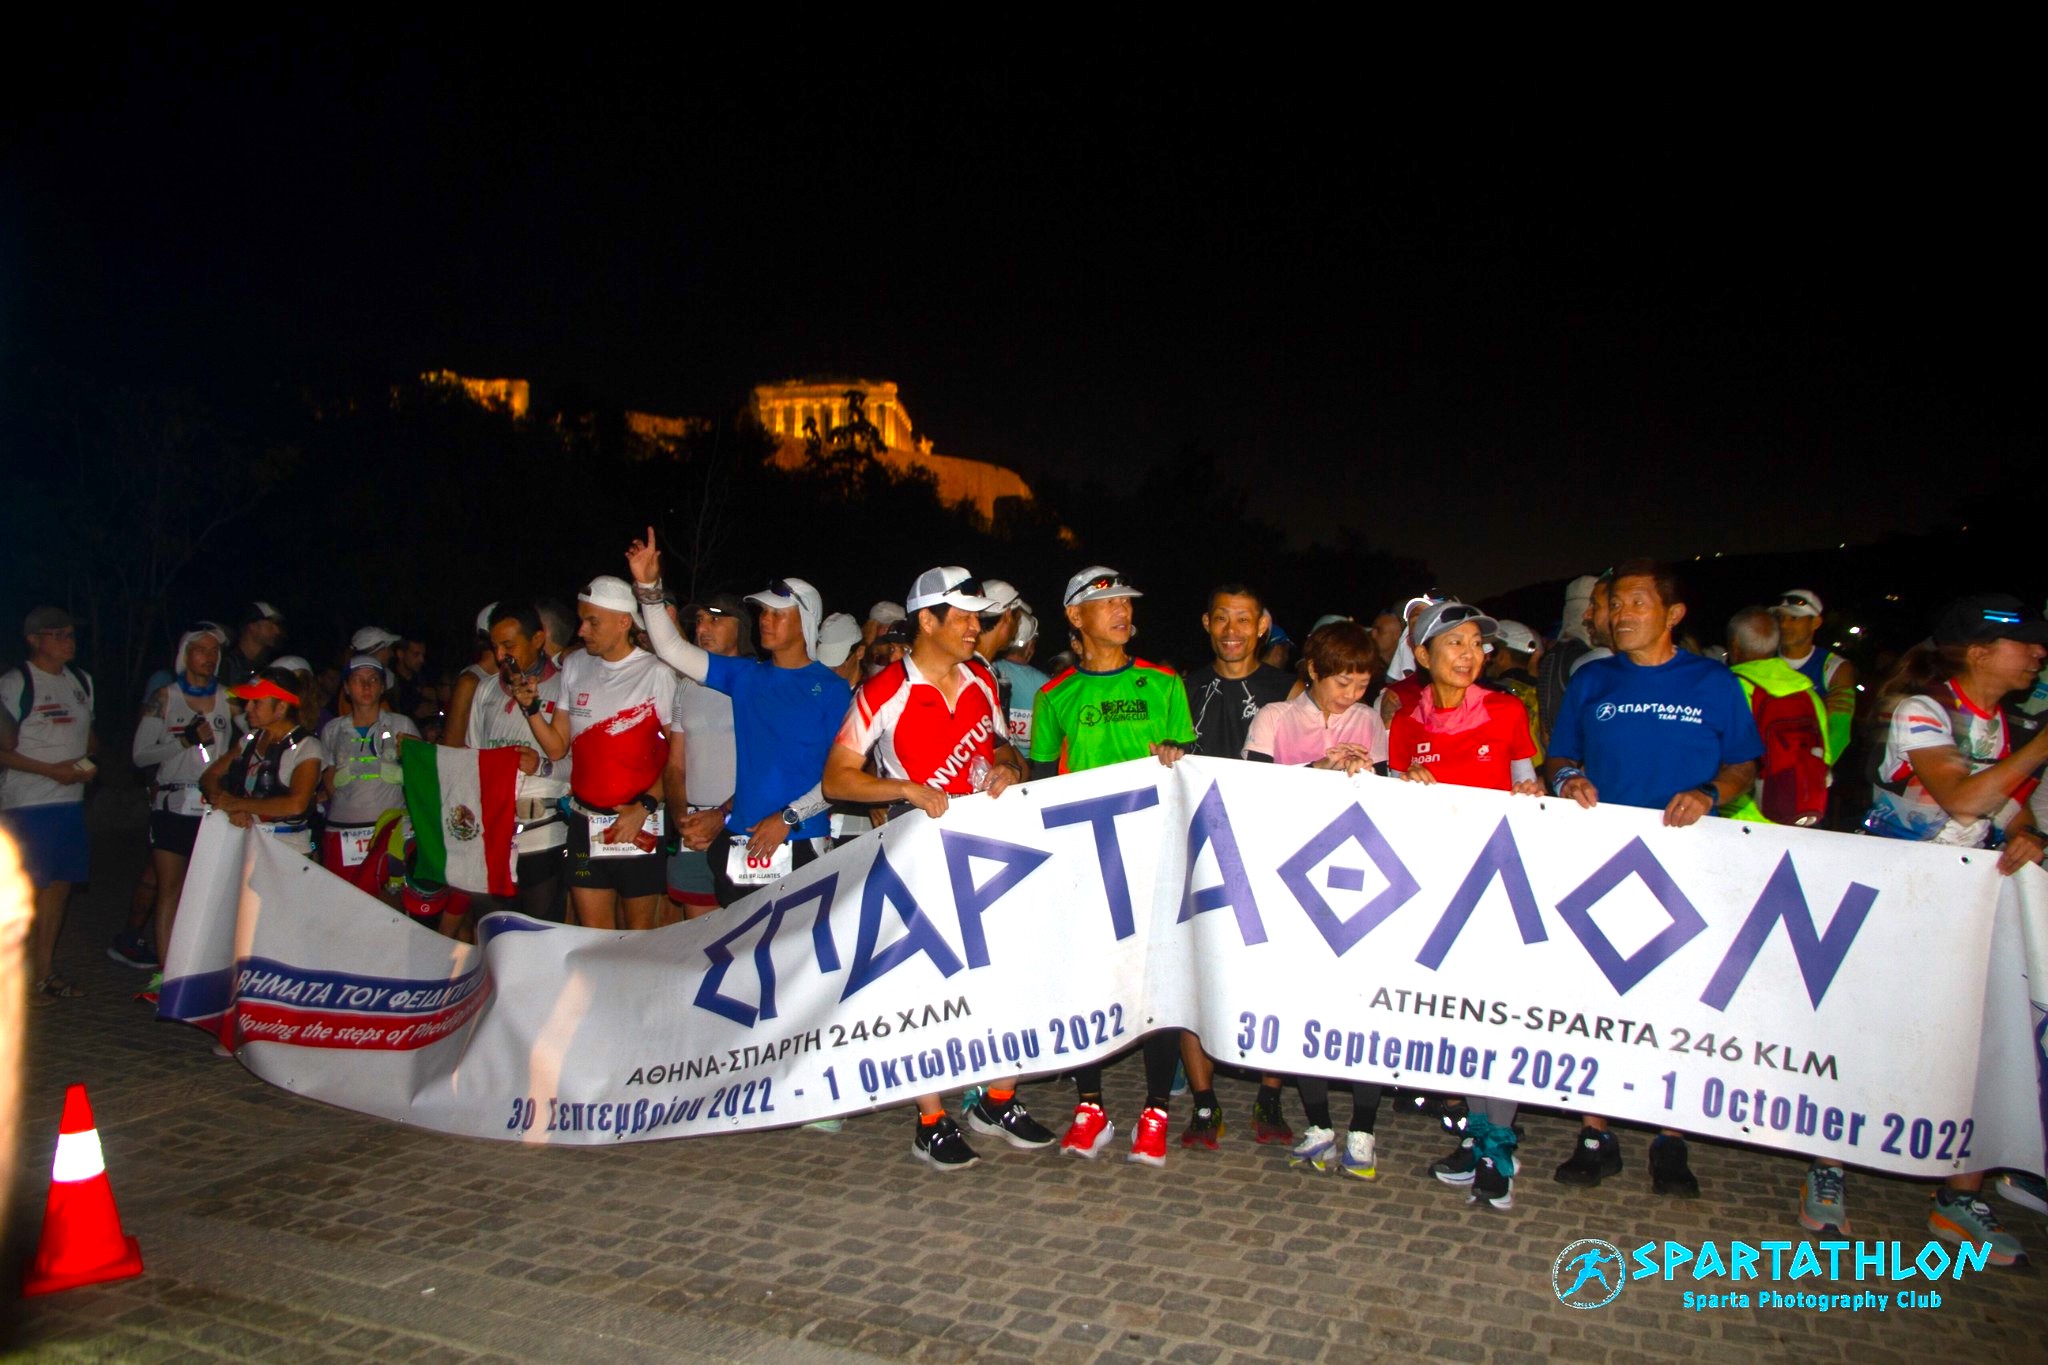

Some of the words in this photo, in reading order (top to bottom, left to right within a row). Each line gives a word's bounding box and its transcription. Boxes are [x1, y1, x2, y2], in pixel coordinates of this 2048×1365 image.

[924, 714, 994, 790] NVICTUS
[1103, 713, 1131, 723] JOGGING
[1658, 713, 1677, 721] TEAM
[1680, 715, 1702, 725] JAPAN
[237, 970, 333, 1004] ΒΗΜΑΤΑ
[336, 984, 390, 1007] ΤΟΥ
[302, 1021, 333, 1039] the
[334, 1027, 384, 1044] steps
[386, 1024, 416, 1045] of
[507, 1096, 535, 1131] 30
[548, 1094, 704, 1134] Σεπτεμβρίου
[707, 1078, 775, 1119] 2022
[824, 1066, 840, 1099] 1
[859, 1027, 1041, 1094] Οκτωβρίου
[1049, 1003, 1125, 1053] 2022
[626, 1029, 823, 1086] ΑΘΗΝΑ-ΣΠΑΡΤΗ
[829, 1013, 891, 1046] 246
[896, 994, 972, 1032] ΧΛΜ
[1370, 986, 1660, 1048] ATHENS-SPARTA
[1669, 1026, 1744, 1060] 246
[1754, 1040, 1839, 1081] KLM
[1238, 1011, 1279, 1055] 30
[1302, 1020, 1497, 1081] September
[1510, 1049, 1599, 1098] 2022
[1660, 1070, 1675, 1111] 1
[1702, 1076, 1866, 1147] October
[1883, 1112, 1975, 1162] 2022
